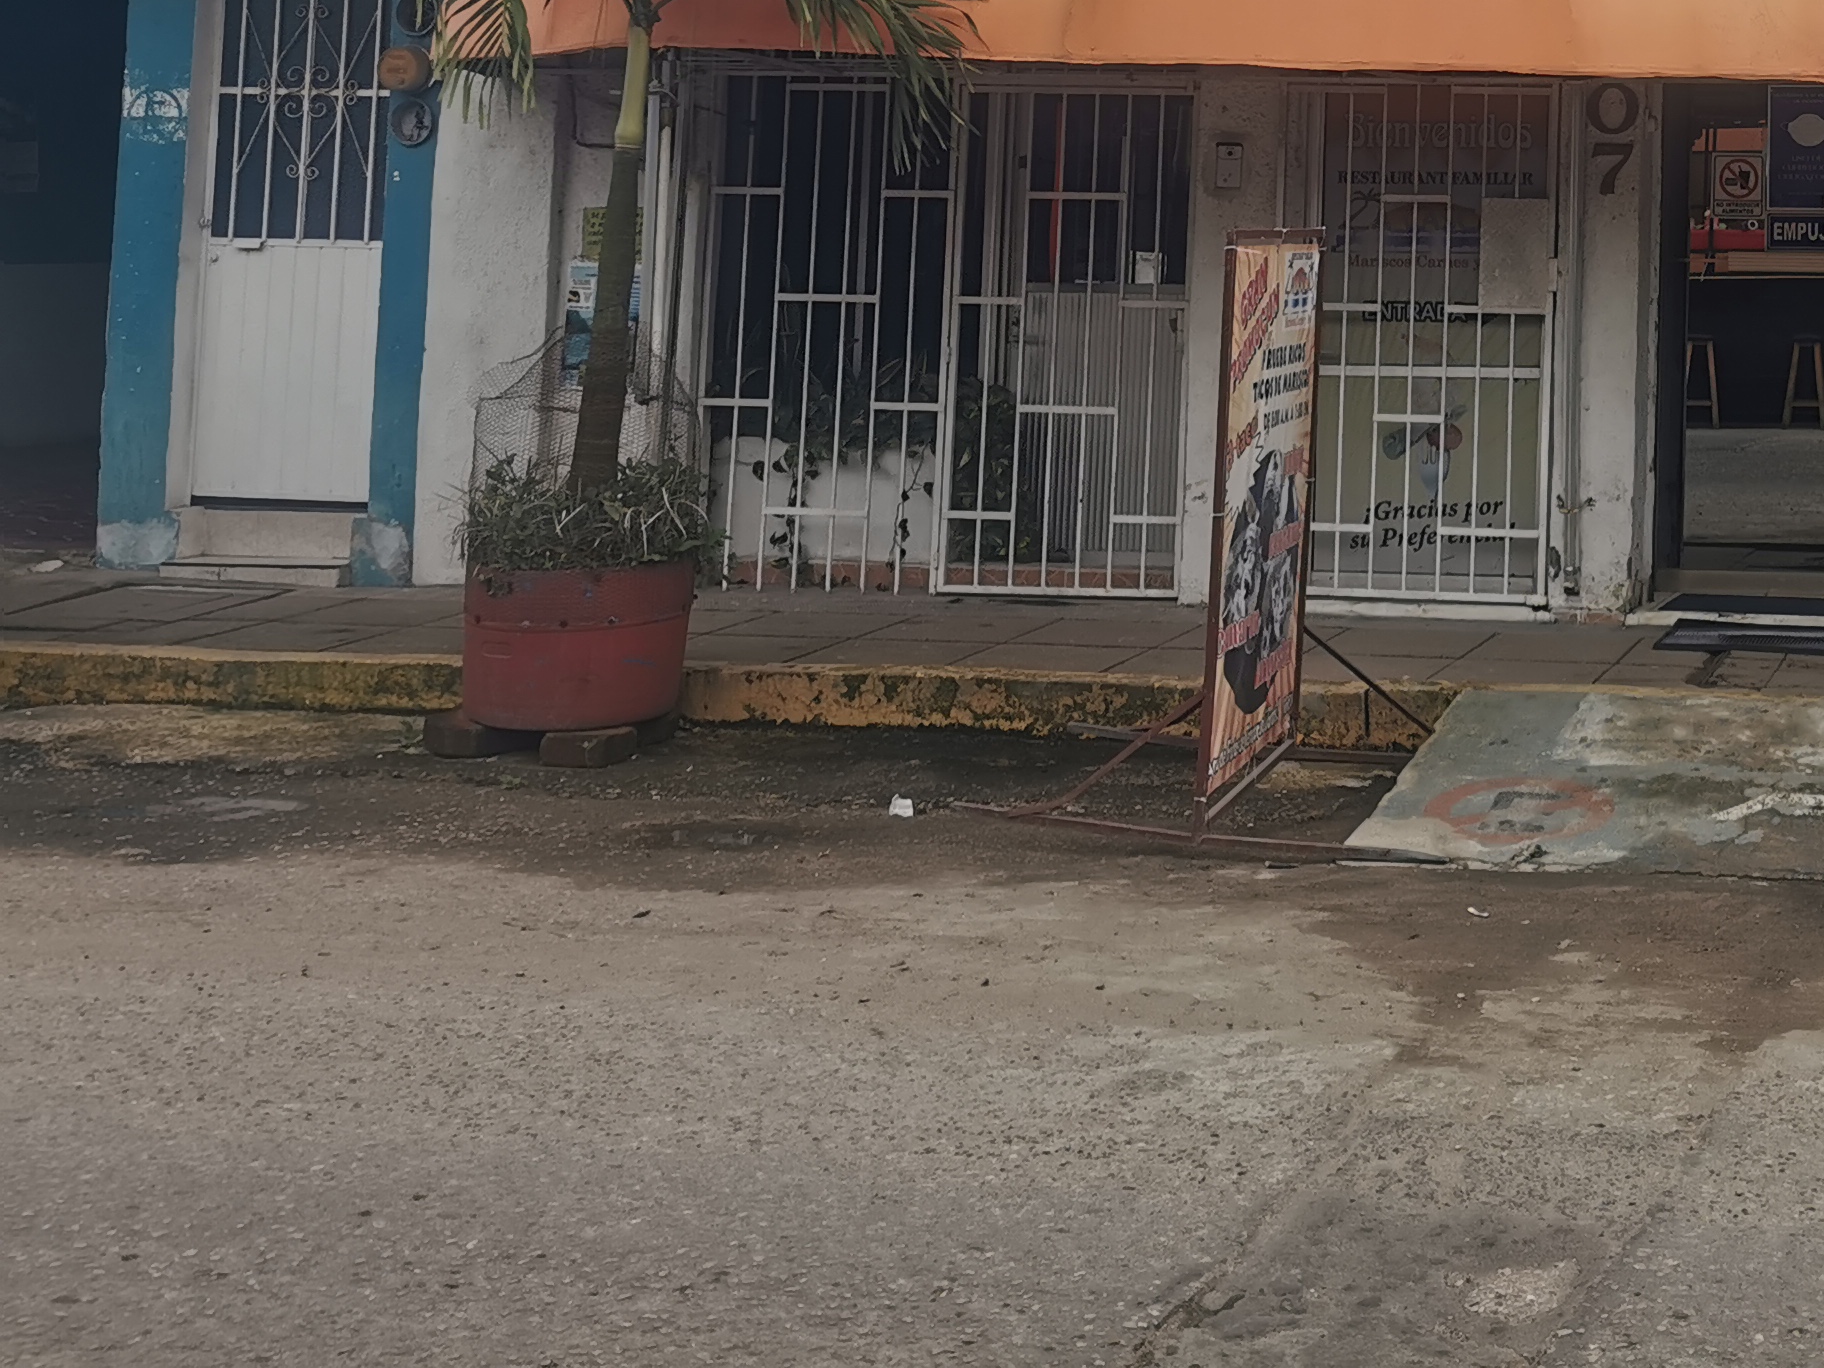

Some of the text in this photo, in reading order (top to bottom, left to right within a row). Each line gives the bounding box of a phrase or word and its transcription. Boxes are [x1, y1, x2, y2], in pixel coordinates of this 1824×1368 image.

[1344, 113, 1532, 149] Bienvenidos
[1337, 170, 1534, 186] RESTAURANT FAMILIAR
[1461, 499, 1504, 524] por
